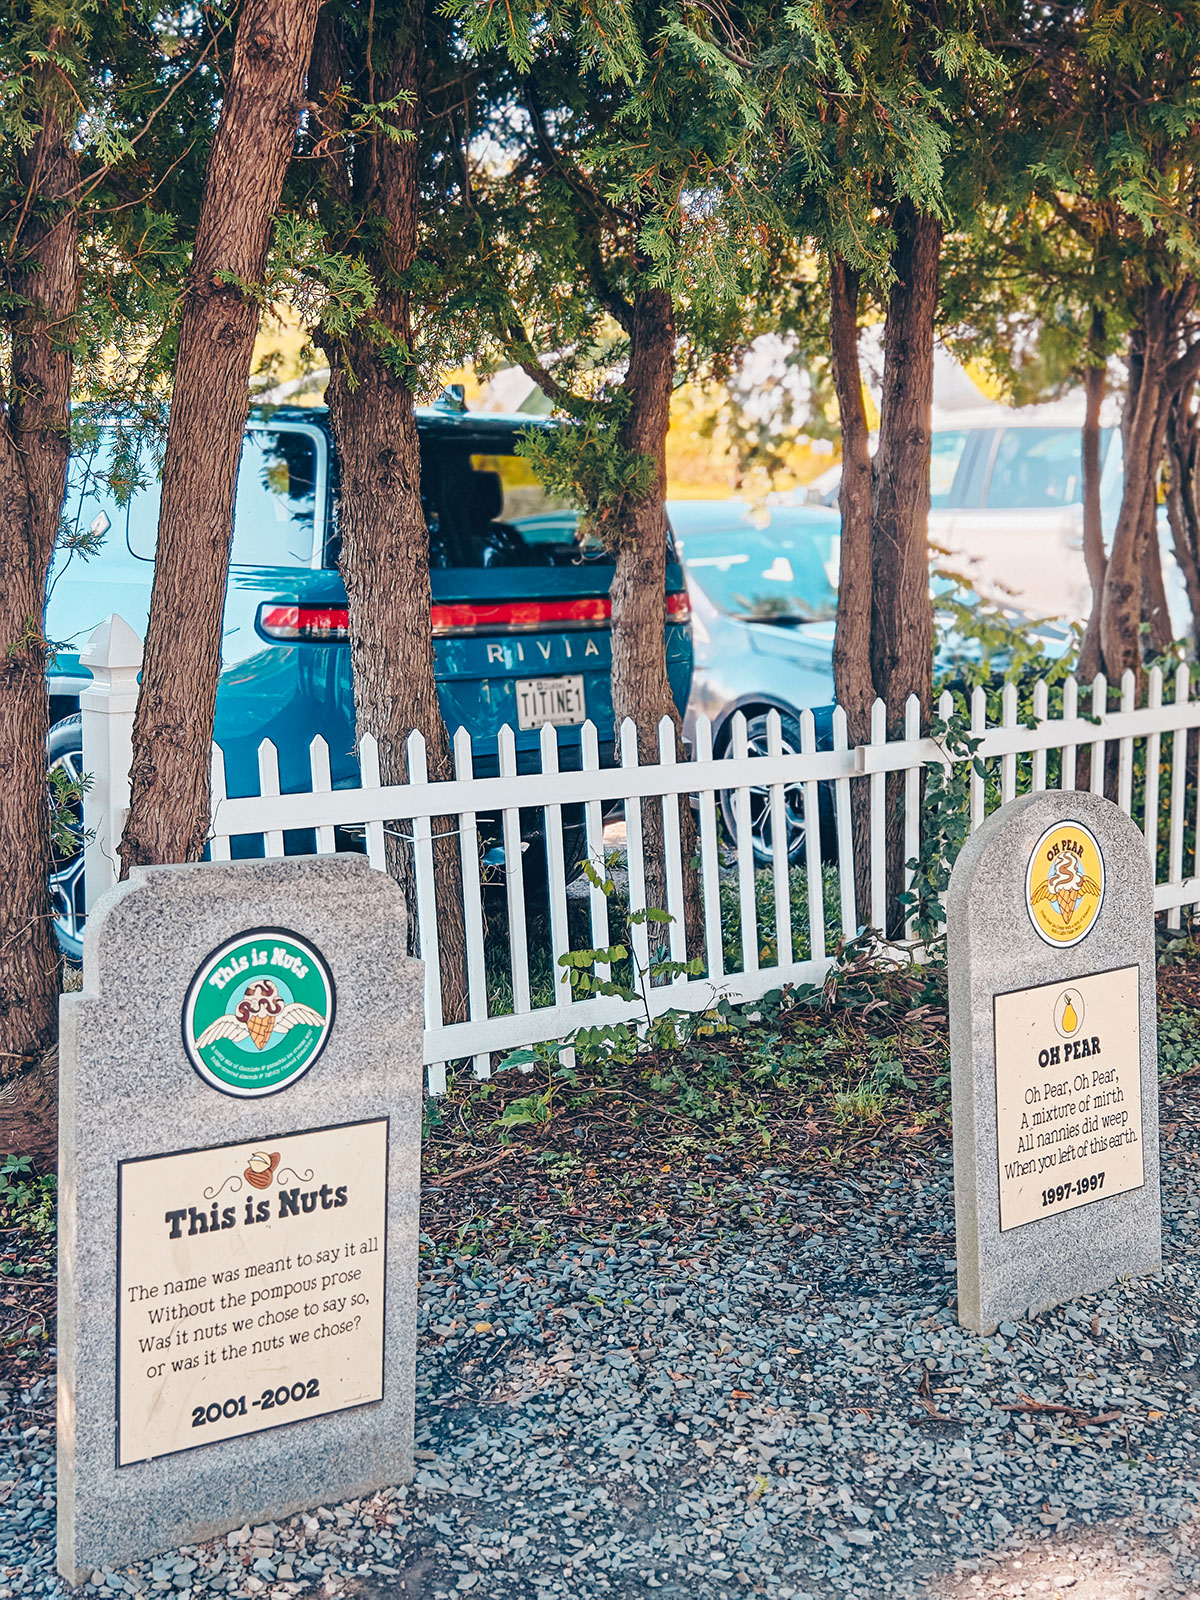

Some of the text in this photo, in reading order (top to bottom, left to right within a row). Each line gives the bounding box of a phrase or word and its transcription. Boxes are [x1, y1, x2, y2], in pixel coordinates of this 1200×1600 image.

[487, 637, 614, 663] RIVIA
[521, 688, 581, 717] TITINE1
[1047, 840, 1084, 862] OH PEAR
[208, 947, 310, 990] This is Nuts
[1038, 1036, 1101, 1068] OH PEAR
[1021, 1087, 1124, 1129] A mixture of mirth
[1025, 1069, 1119, 1105] Oh Pear, Oh Pear,
[1004, 1128, 1138, 1180] When you left of this earth.
[1018, 1111, 1128, 1154] All nannies did weep
[1042, 1172, 1105, 1207] 1997-1997
[165, 1184, 348, 1240] This is Nuts
[128, 1237, 378, 1302] The name was meant to say it all
[148, 1270, 361, 1324] Without the pompous prose
[139, 1294, 369, 1353] Was it nuts we chose to say so,
[147, 1316, 361, 1378] or was it the nuts we chose?
